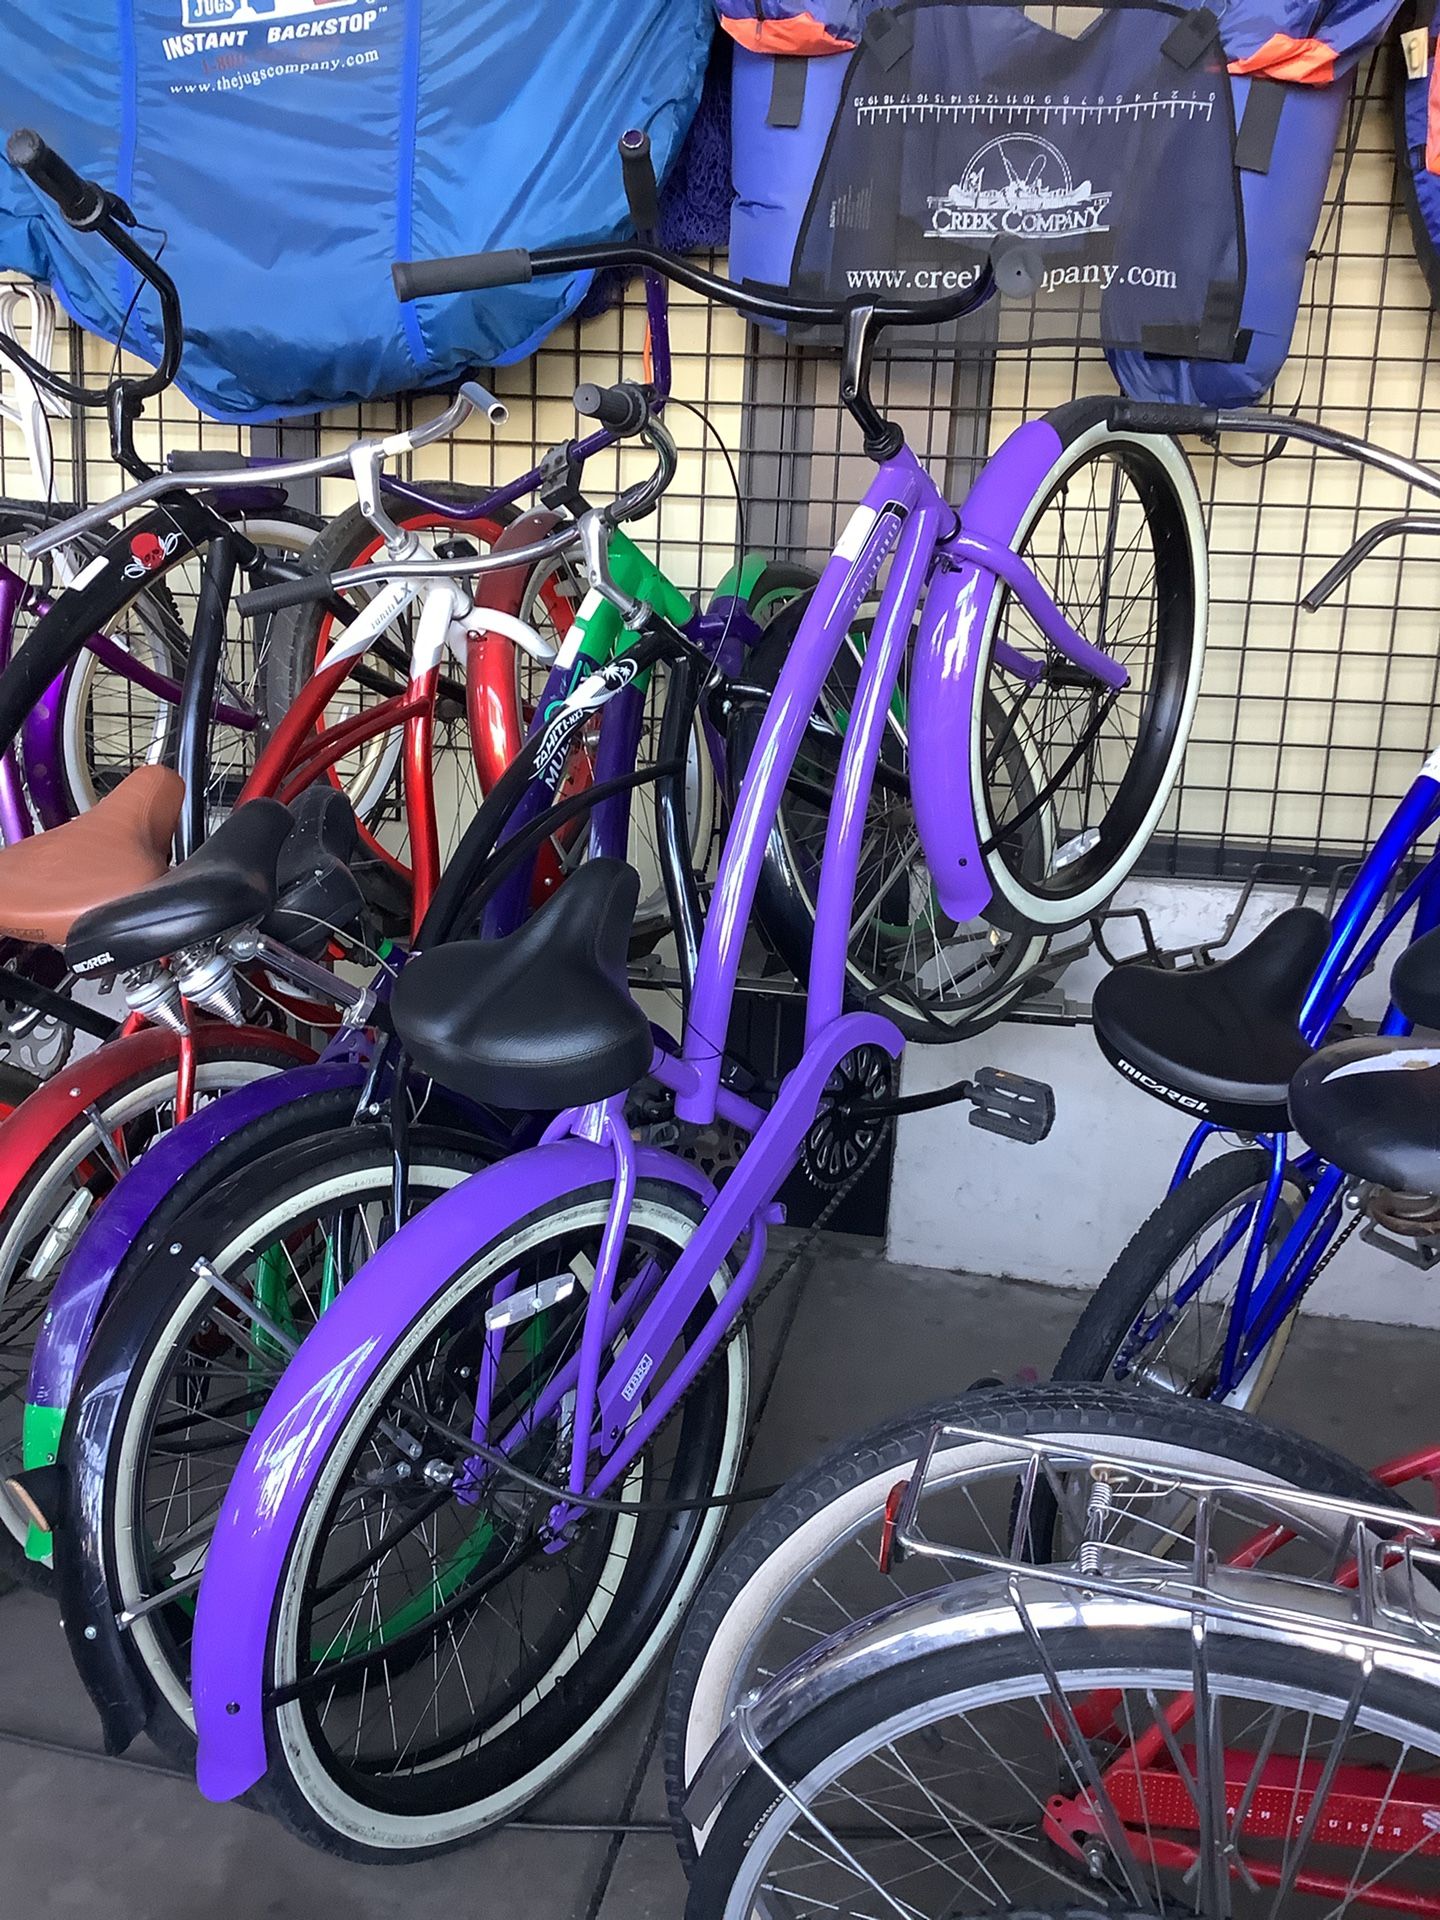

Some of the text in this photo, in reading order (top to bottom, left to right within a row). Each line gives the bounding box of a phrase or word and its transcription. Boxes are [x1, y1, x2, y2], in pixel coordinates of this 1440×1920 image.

[194, 0, 235, 17] JUGS
[162, 30, 248, 60] INSTANT
[170, 49, 379, 94] www.thejugscompany.com
[884, 94, 895, 105] 18
[900, 93, 911, 104] 17
[917, 93, 929, 104] 16
[934, 93, 945, 104] 15
[950, 94, 962, 104] 14
[968, 94, 981, 104] 13
[986, 94, 999, 104] 12
[1006, 94, 1018, 105] 11
[1023, 94, 1036, 105] 10
[1044, 94, 1052, 105] 9
[1080, 95, 1087, 105] 7
[1134, 93, 1141, 103] 4
[1153, 91, 1159, 100] 3
[1171, 90, 1179, 99] 2
[1191, 90, 1197, 99] 1
[1209, 92, 1216, 102] 0
[867, 95, 879, 106] 19
[932, 208, 999, 233] CREEK
[846, 264, 1177, 293] www.creepany.com
[1295, 1814, 1402, 1837] CUISER
